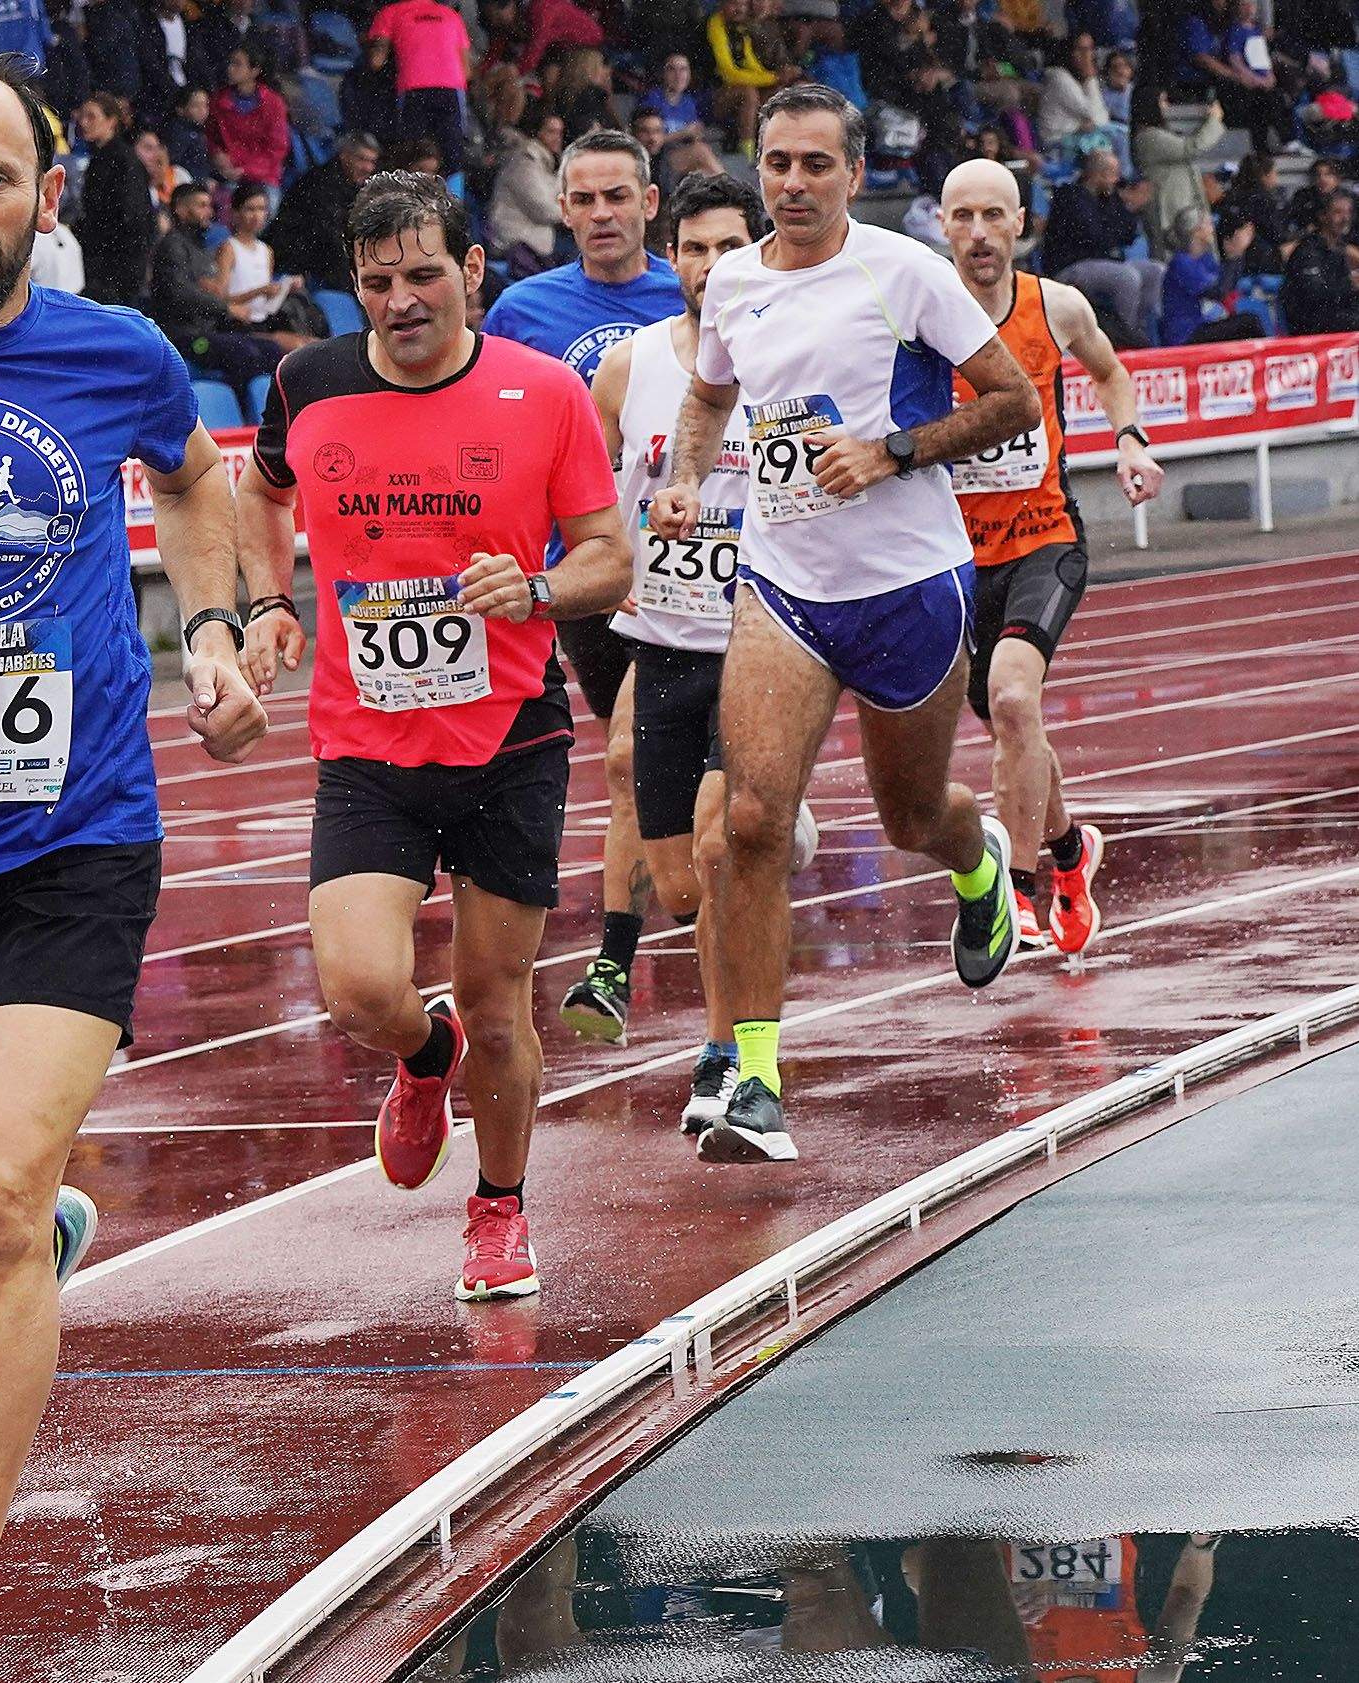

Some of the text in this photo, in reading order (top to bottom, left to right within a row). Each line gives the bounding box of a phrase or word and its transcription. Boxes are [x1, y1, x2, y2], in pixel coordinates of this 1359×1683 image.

[566, 337, 596, 366] VETE
[1, 411, 80, 504] DIABETES
[387, 473, 421, 487] XXVII
[338, 490, 482, 516] SAN MARTIÑO
[34, 551, 62, 585] 2024
[649, 535, 738, 583] 230
[366, 578, 446, 602] XI MILLA
[389, 603, 417, 617] POLA
[418, 600, 463, 613] DIABETE
[353, 615, 472, 670] 309
